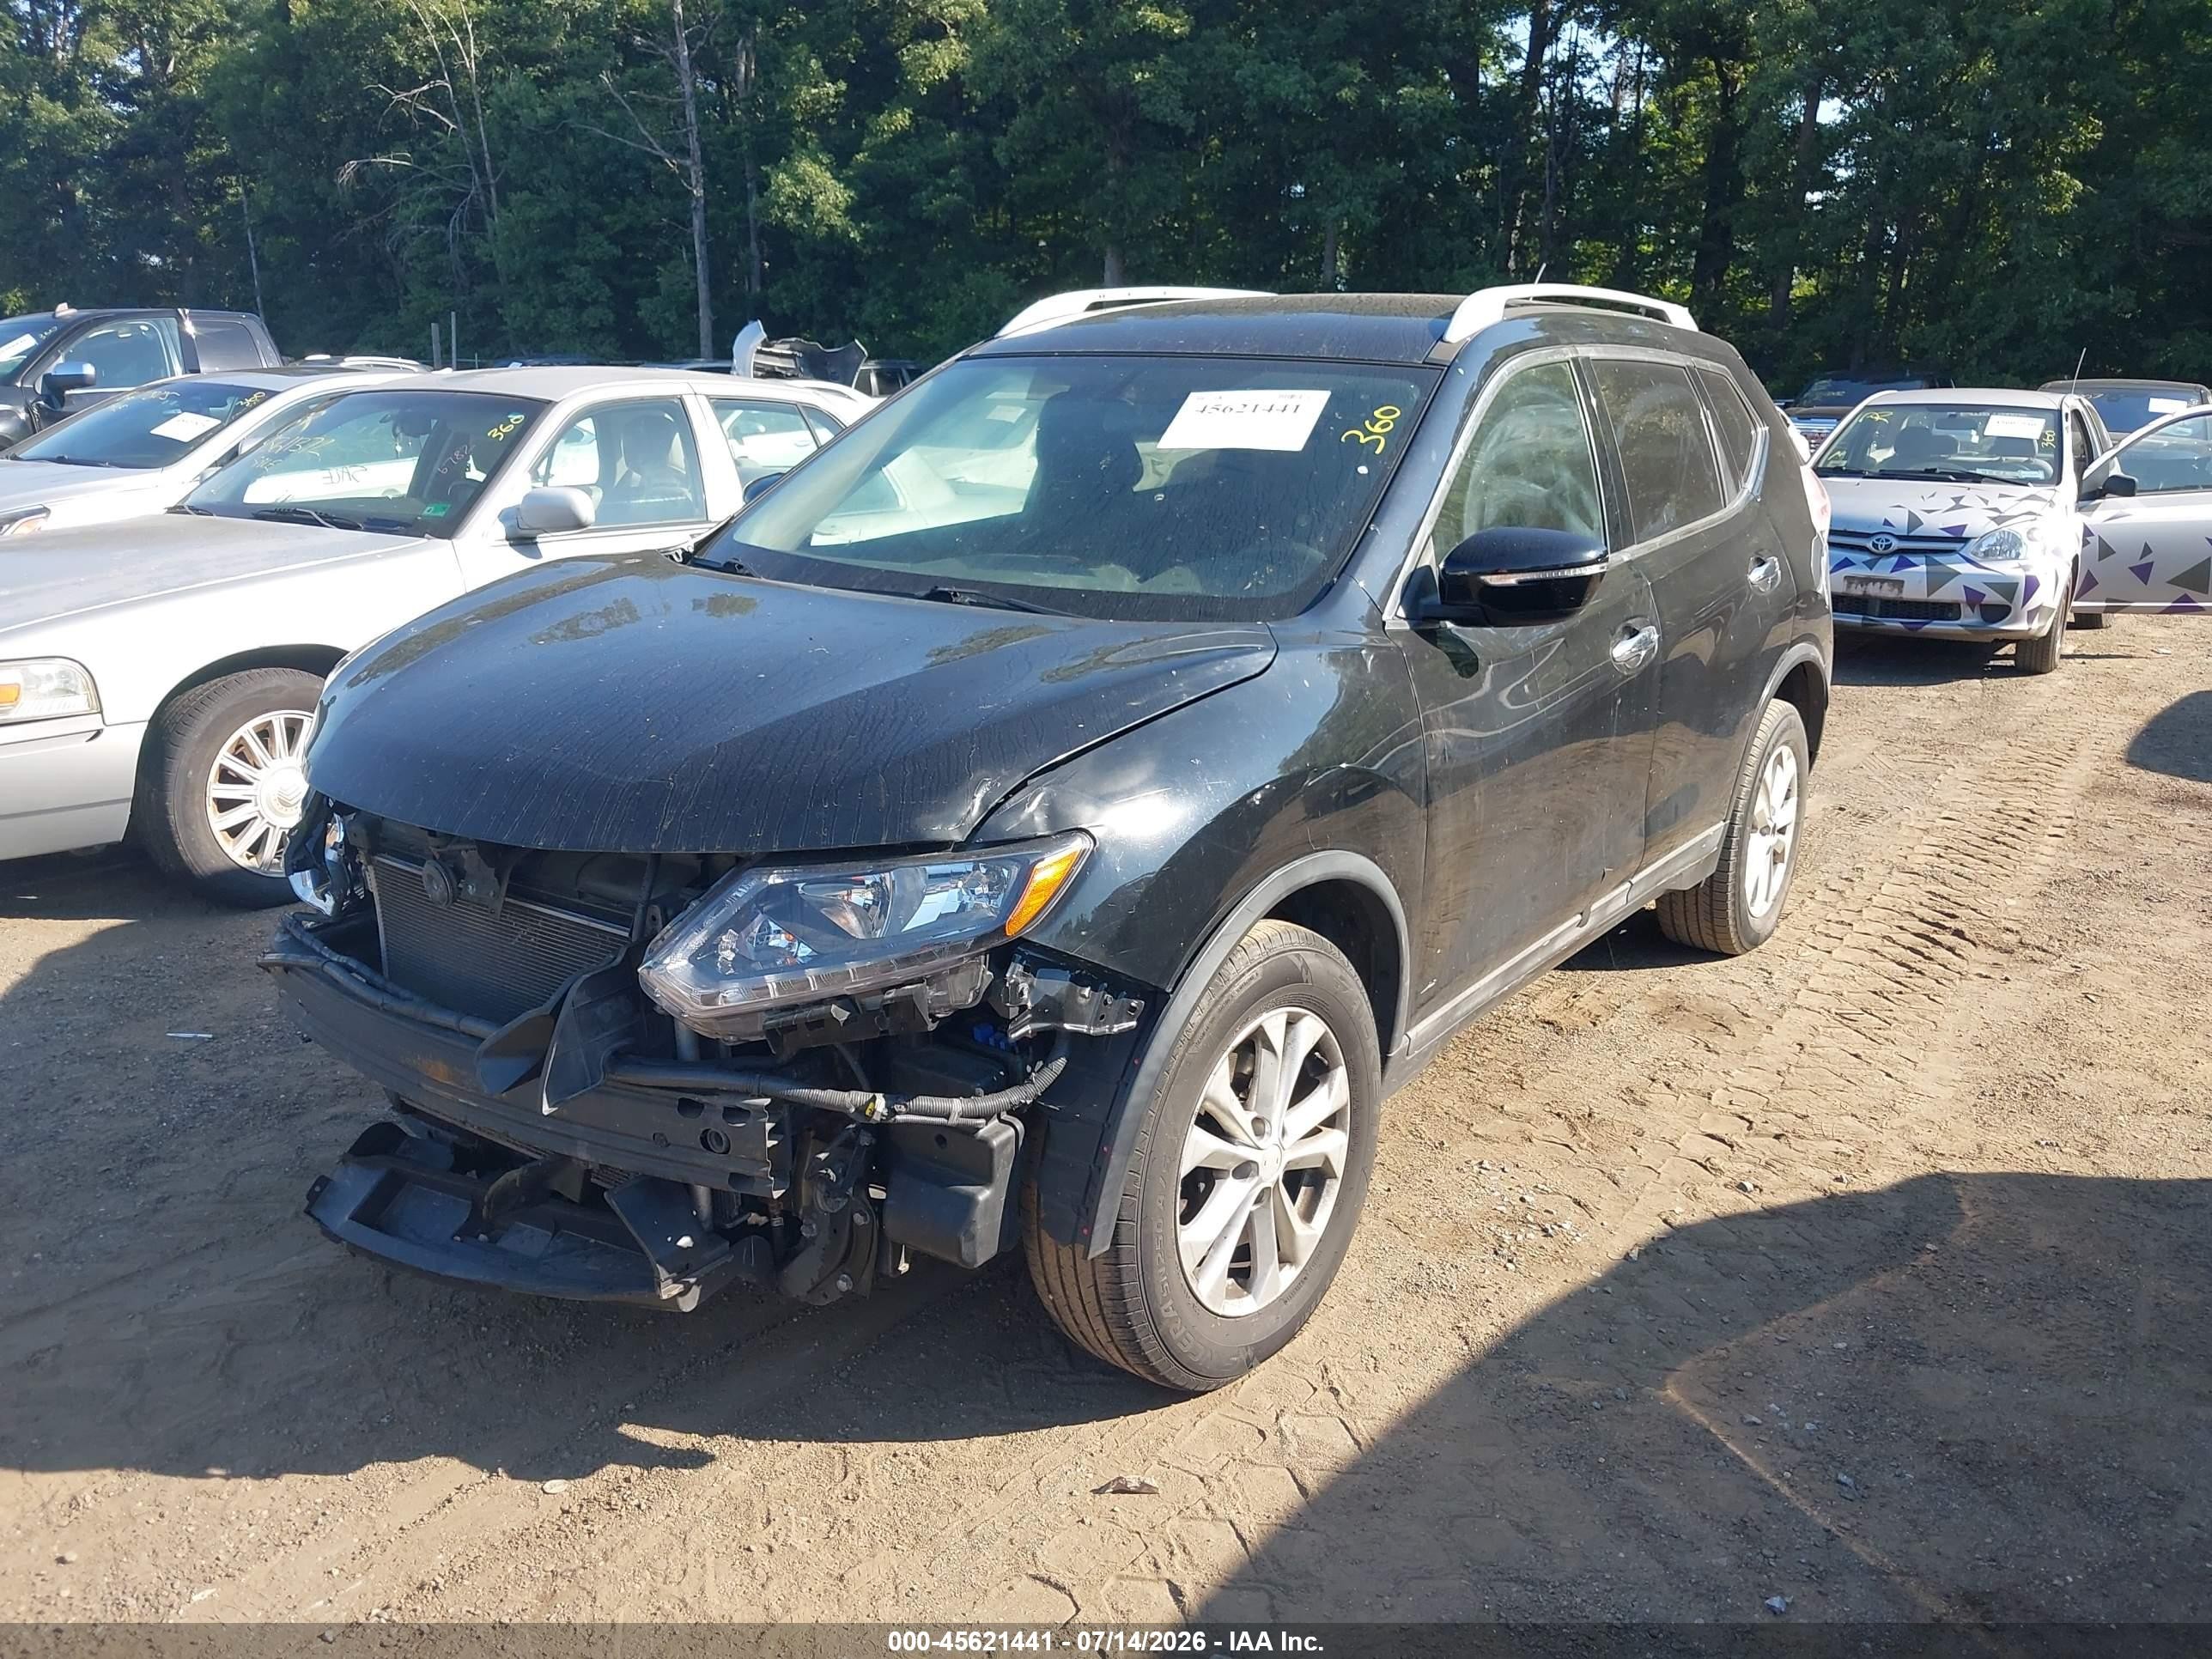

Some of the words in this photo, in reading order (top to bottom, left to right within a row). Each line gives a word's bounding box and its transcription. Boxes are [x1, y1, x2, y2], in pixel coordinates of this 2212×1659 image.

[487, 411, 526, 441] 360
[1340, 404, 1401, 455] 360
[2041, 429, 2057, 449] 360
